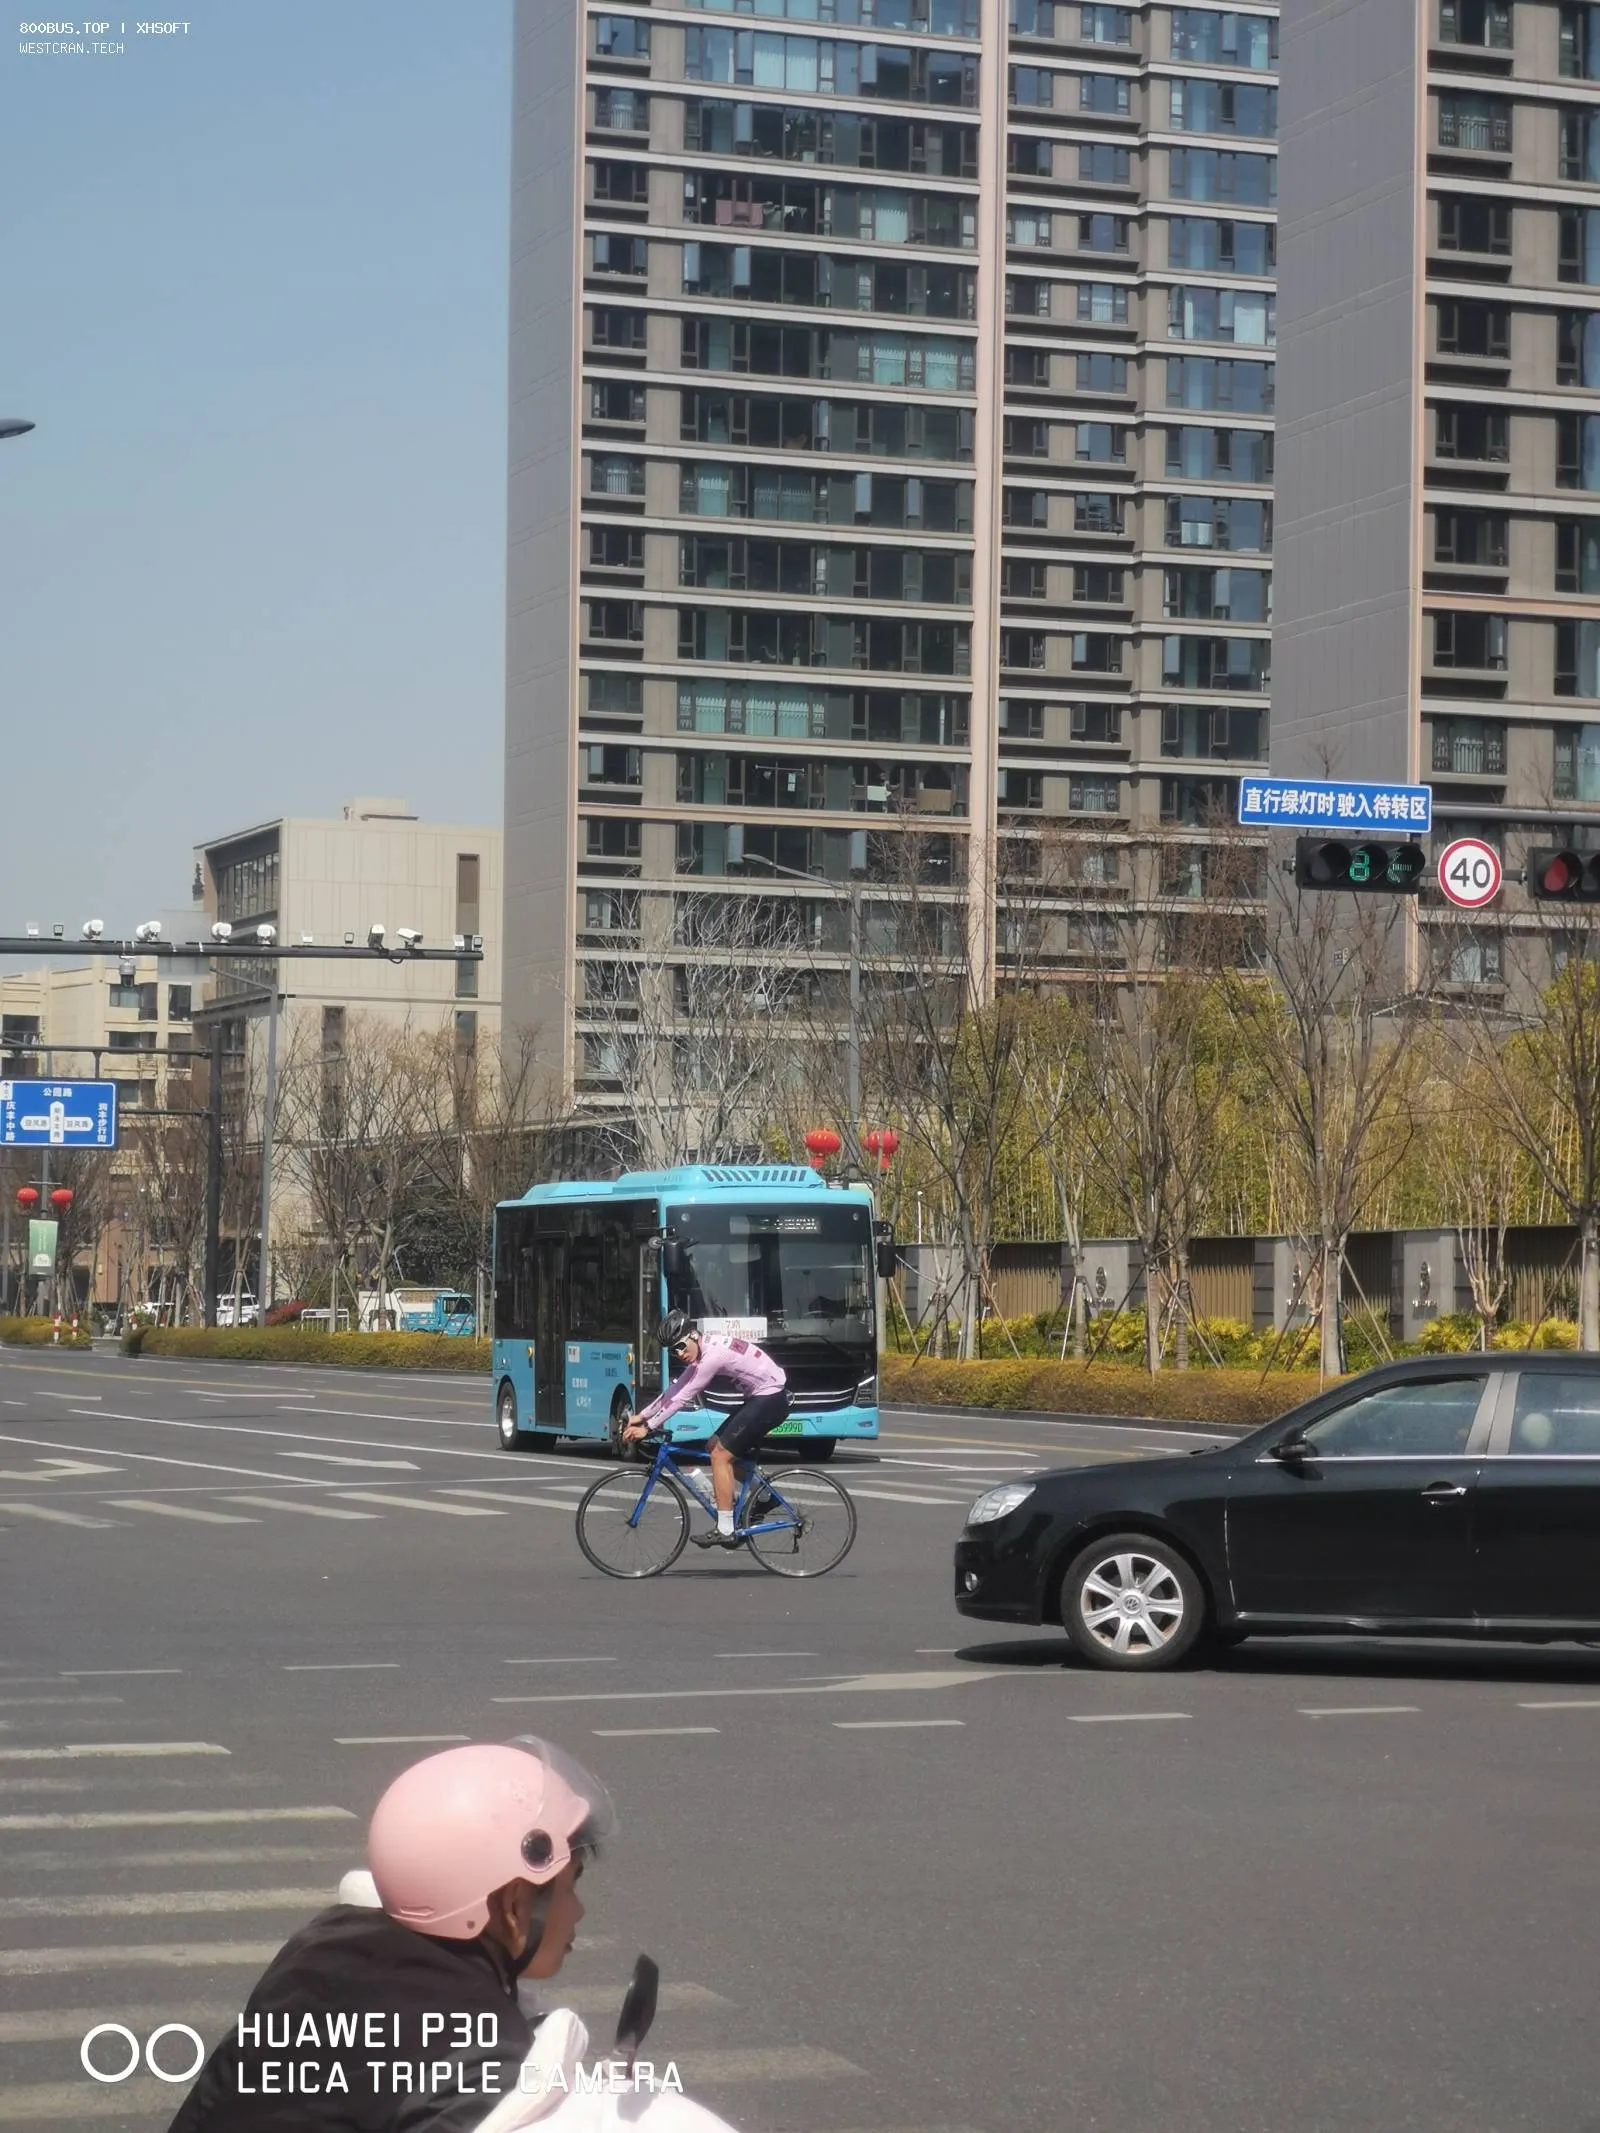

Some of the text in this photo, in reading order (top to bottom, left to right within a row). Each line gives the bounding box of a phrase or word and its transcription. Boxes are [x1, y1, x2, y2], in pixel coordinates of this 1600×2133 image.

[1243, 787, 1427, 820] 直行绿灯时驶入待转区
[1450, 858, 1491, 888] 40
